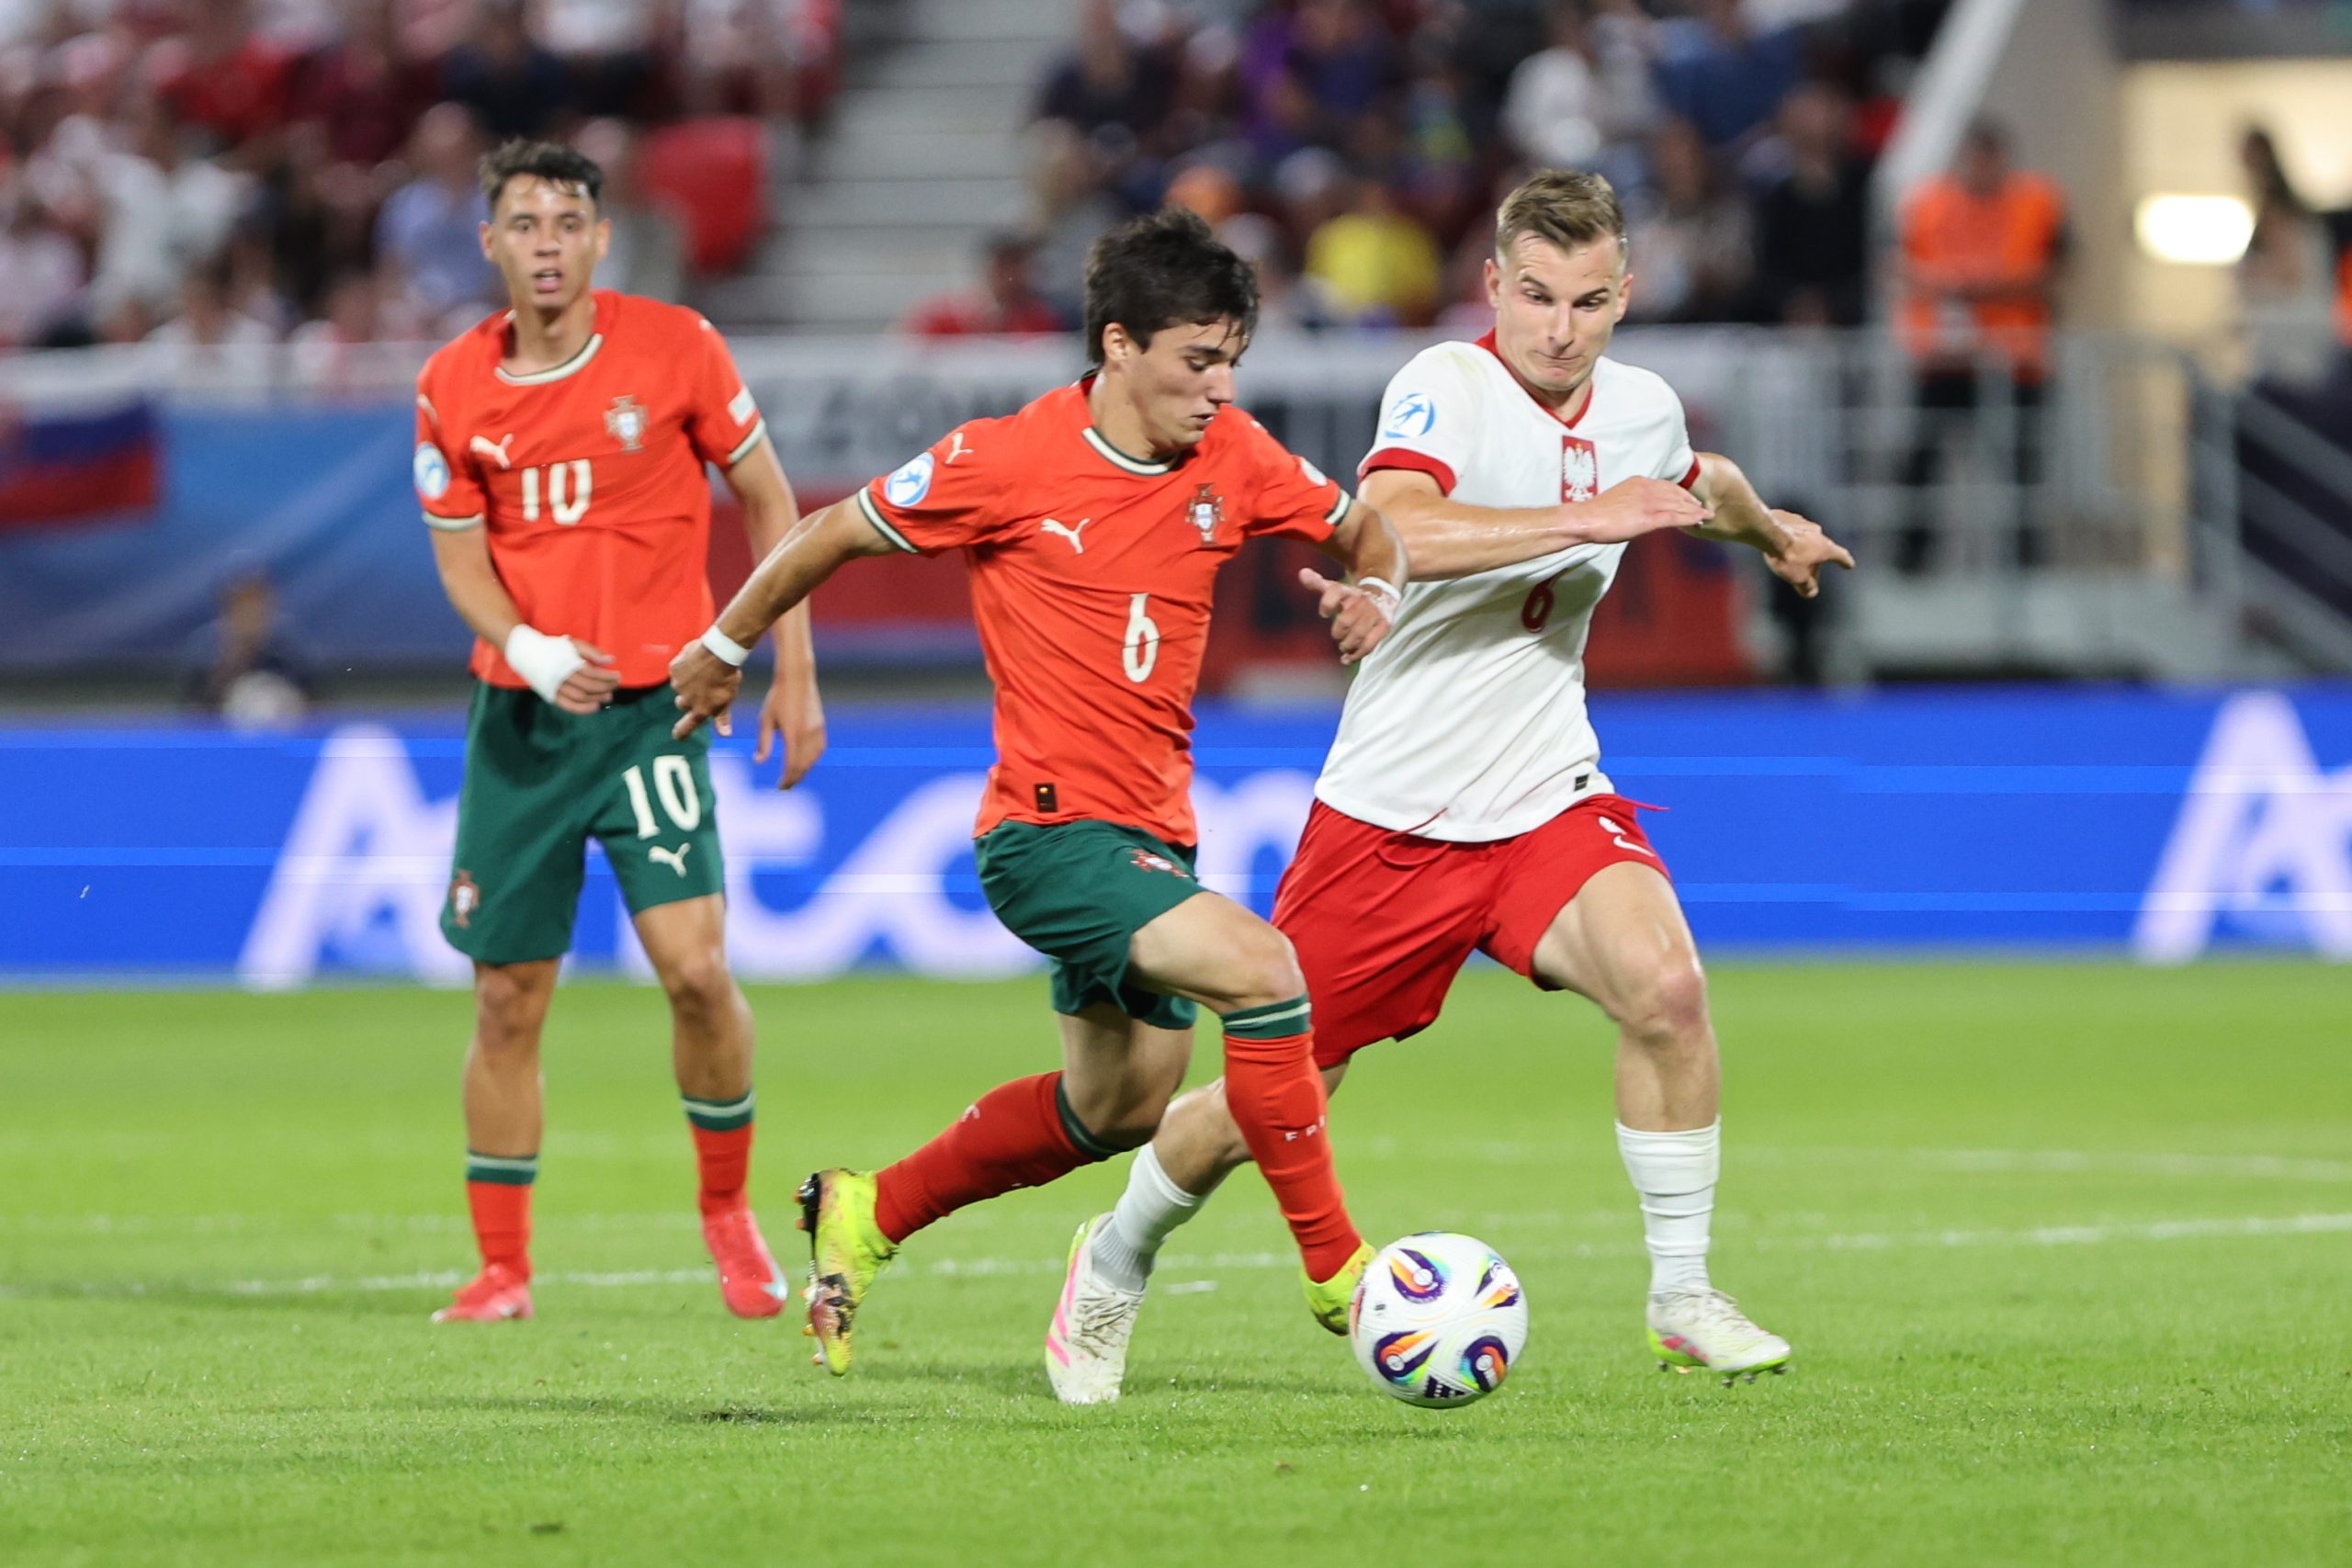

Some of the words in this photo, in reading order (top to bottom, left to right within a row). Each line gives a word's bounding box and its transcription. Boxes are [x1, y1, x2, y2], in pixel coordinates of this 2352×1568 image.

[521, 460, 594, 525] 10
[1121, 592, 1161, 684] 6
[1521, 573, 1556, 634] 6
[621, 754, 702, 840] 10
